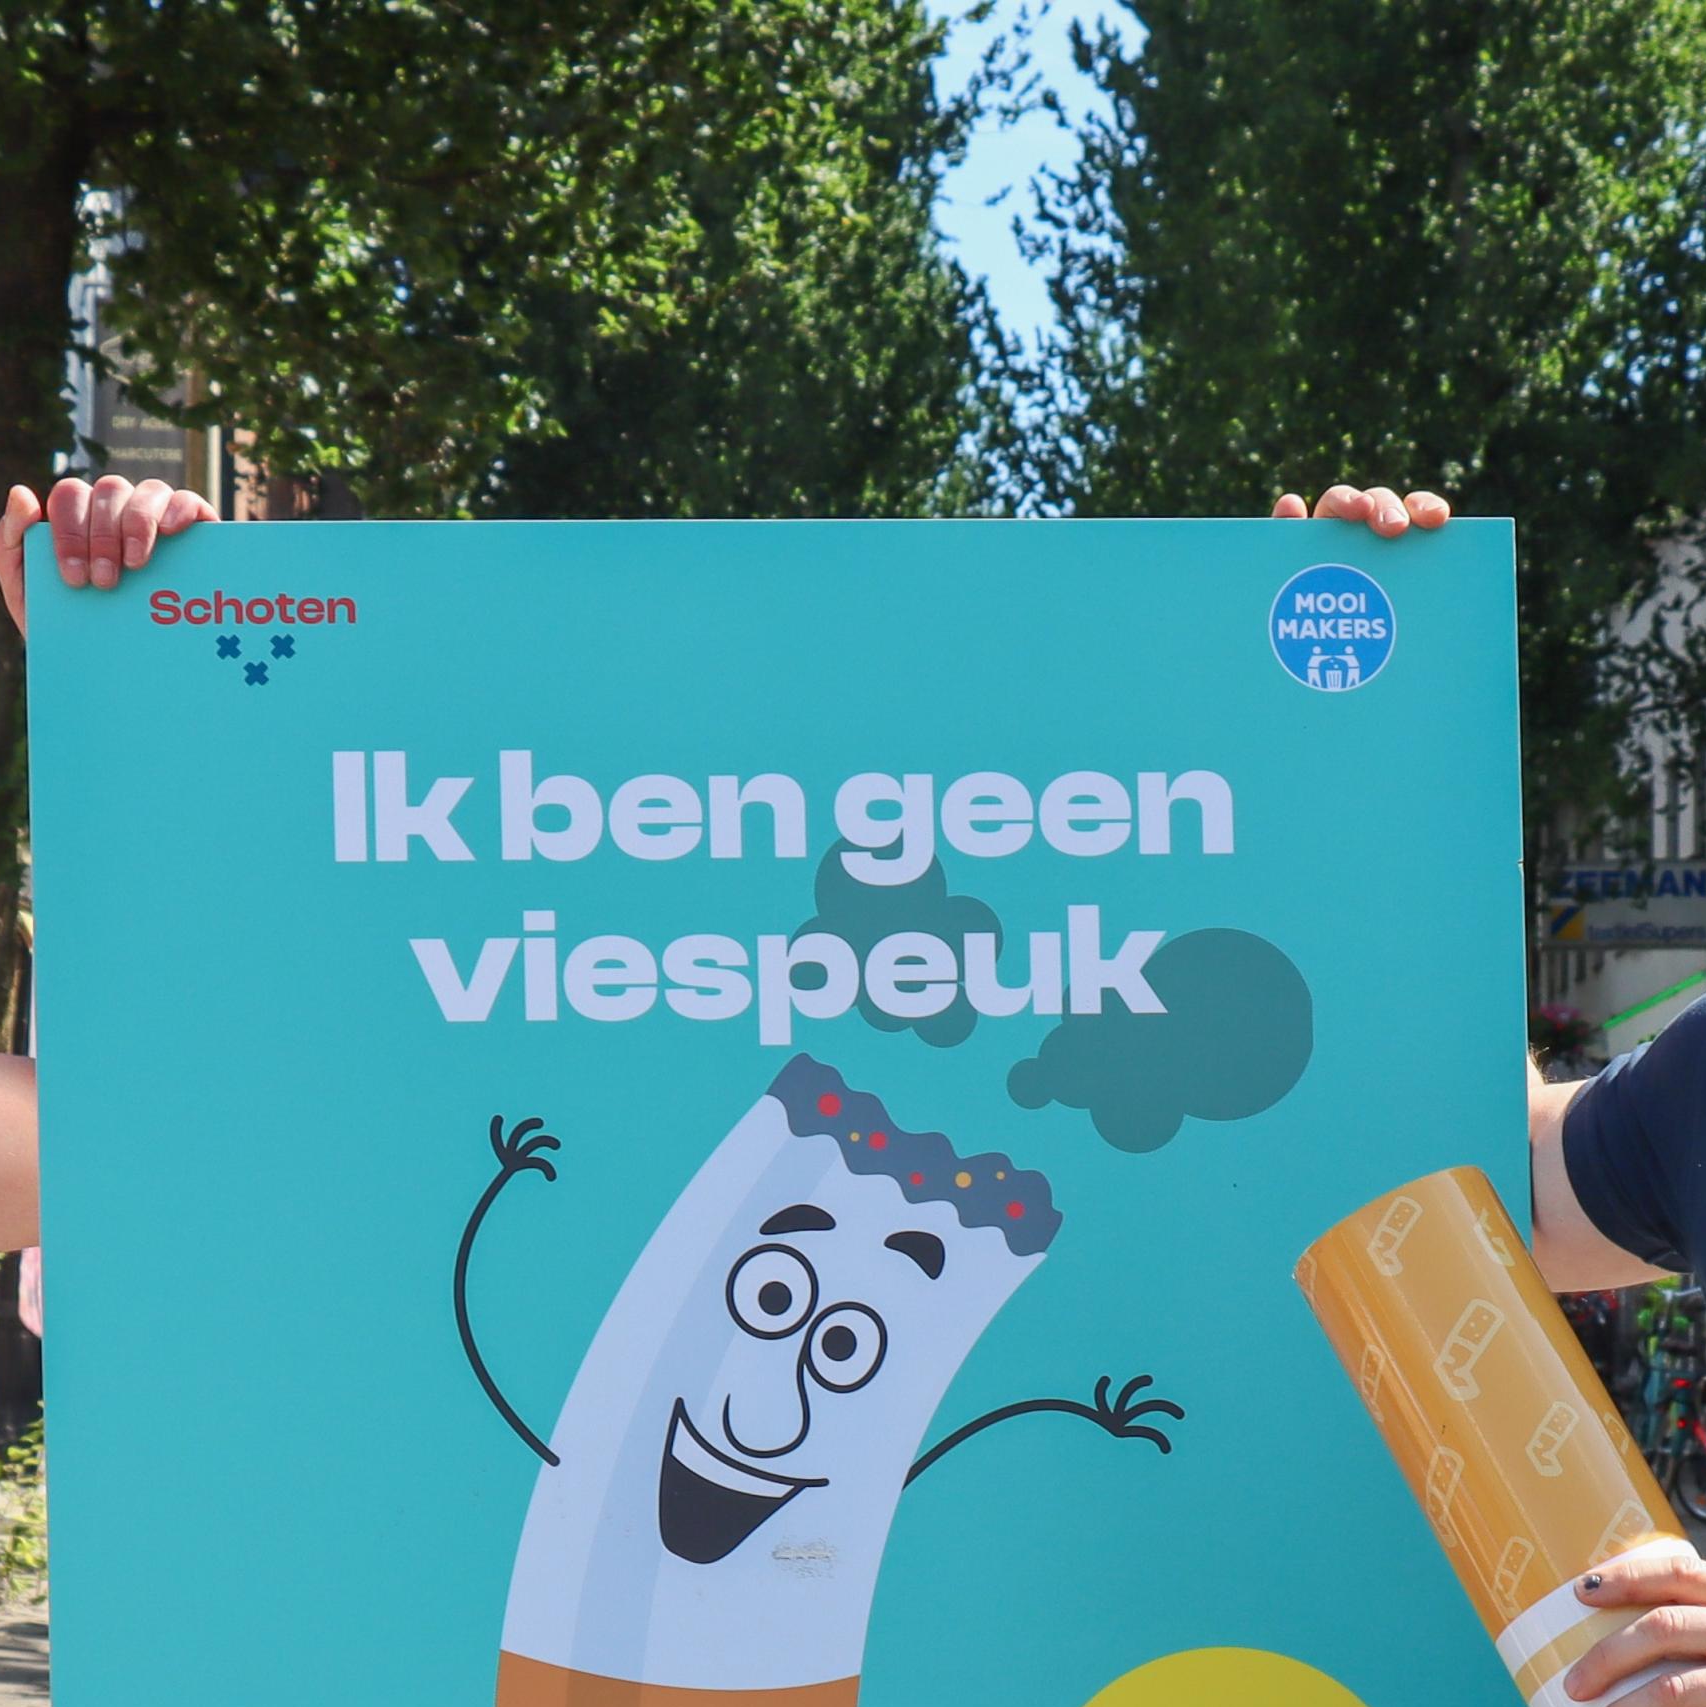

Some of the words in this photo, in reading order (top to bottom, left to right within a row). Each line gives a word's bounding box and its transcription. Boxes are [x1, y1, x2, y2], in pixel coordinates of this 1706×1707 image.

[152, 590, 355, 624] Schoten
[1296, 593, 1365, 613] MOOI
[1277, 618, 1388, 640] MAKERS
[333, 751, 474, 862] Ik
[500, 751, 806, 861] ben
[835, 771, 1233, 885] geen
[410, 905, 1167, 1045] viespeuk
